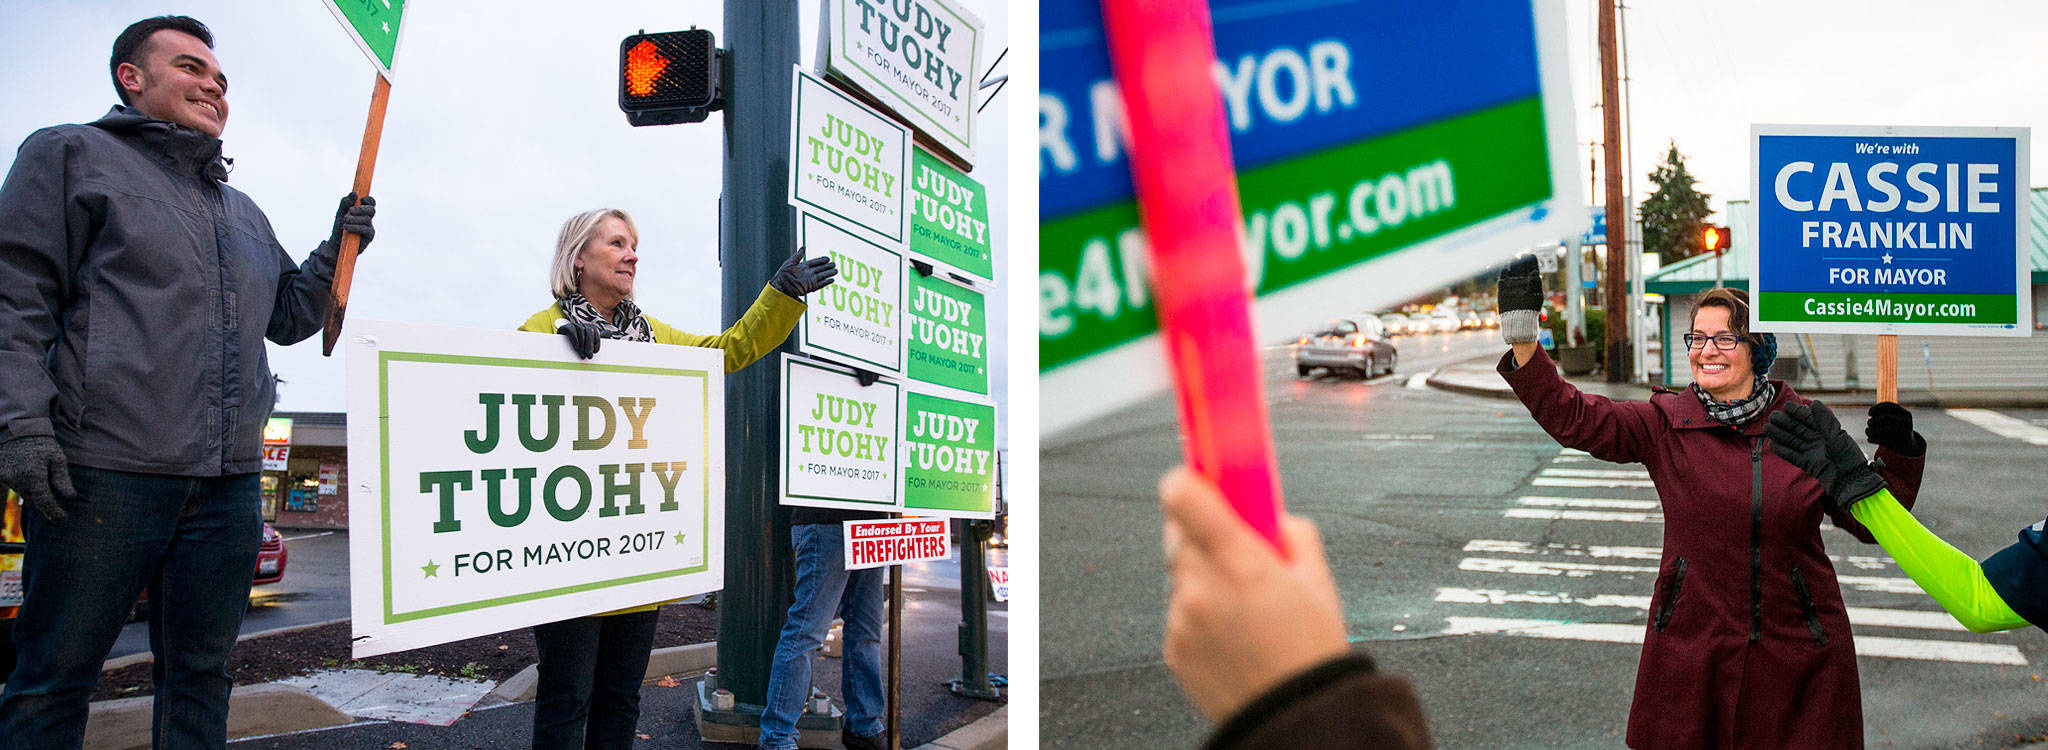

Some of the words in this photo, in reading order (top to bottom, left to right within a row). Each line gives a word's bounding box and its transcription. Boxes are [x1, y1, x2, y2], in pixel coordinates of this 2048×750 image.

[876, 0, 951, 53] UDY
[855, 0, 962, 101] TUOHY
[867, 46, 891, 72] FOR
[893, 67, 929, 101] MAYOR
[931, 95, 953, 117] 2017
[821, 113, 885, 164] JUDY
[1855, 142, 1890, 155] We're
[1892, 142, 1920, 155] with
[808, 135, 895, 199] TUOHY
[816, 174, 836, 194] FOR
[837, 182, 867, 206] MAYOR
[869, 198, 887, 213] 2017
[916, 164, 974, 213] JUDY
[1774, 160, 2001, 214] CASSIE
[913, 223, 932, 240] FOR
[933, 231, 962, 251] MAYOR
[963, 243, 980, 258] 2017
[1802, 221, 1973, 250] FRANKLIN
[1829, 267, 1870, 285] FOR
[1874, 267, 1947, 286] MAYOR
[913, 285, 973, 328] JUDY
[1804, 297, 1977, 322] Cassie4Mayor.com
[823, 315, 842, 331] FOR
[842, 321, 870, 341] MAYOR
[870, 330, 887, 345] 2017
[909, 348, 930, 364] FOR
[929, 352, 957, 371] MAYOR
[957, 360, 976, 375] 2017
[464, 392, 656, 455] JUDY
[811, 392, 878, 430] JUDY
[913, 410, 980, 445] JUDY
[798, 423, 889, 462] TUOHY
[807, 462, 828, 476] FOR
[829, 465, 860, 479] MAYOR
[861, 468, 880, 481] 2017
[908, 476, 927, 490] FOR
[927, 477, 959, 492] MAYOR
[960, 481, 980, 493] 2017
[418, 460, 688, 535] TUOHY
[855, 525, 902, 538] Endorsed
[904, 523, 918, 537] By
[919, 522, 941, 534] Your
[453, 548, 513, 577] FOR
[523, 536, 611, 568] MAYOR
[618, 530, 667, 555] 2017
[852, 536, 946, 565] FIREFIGHTERS
